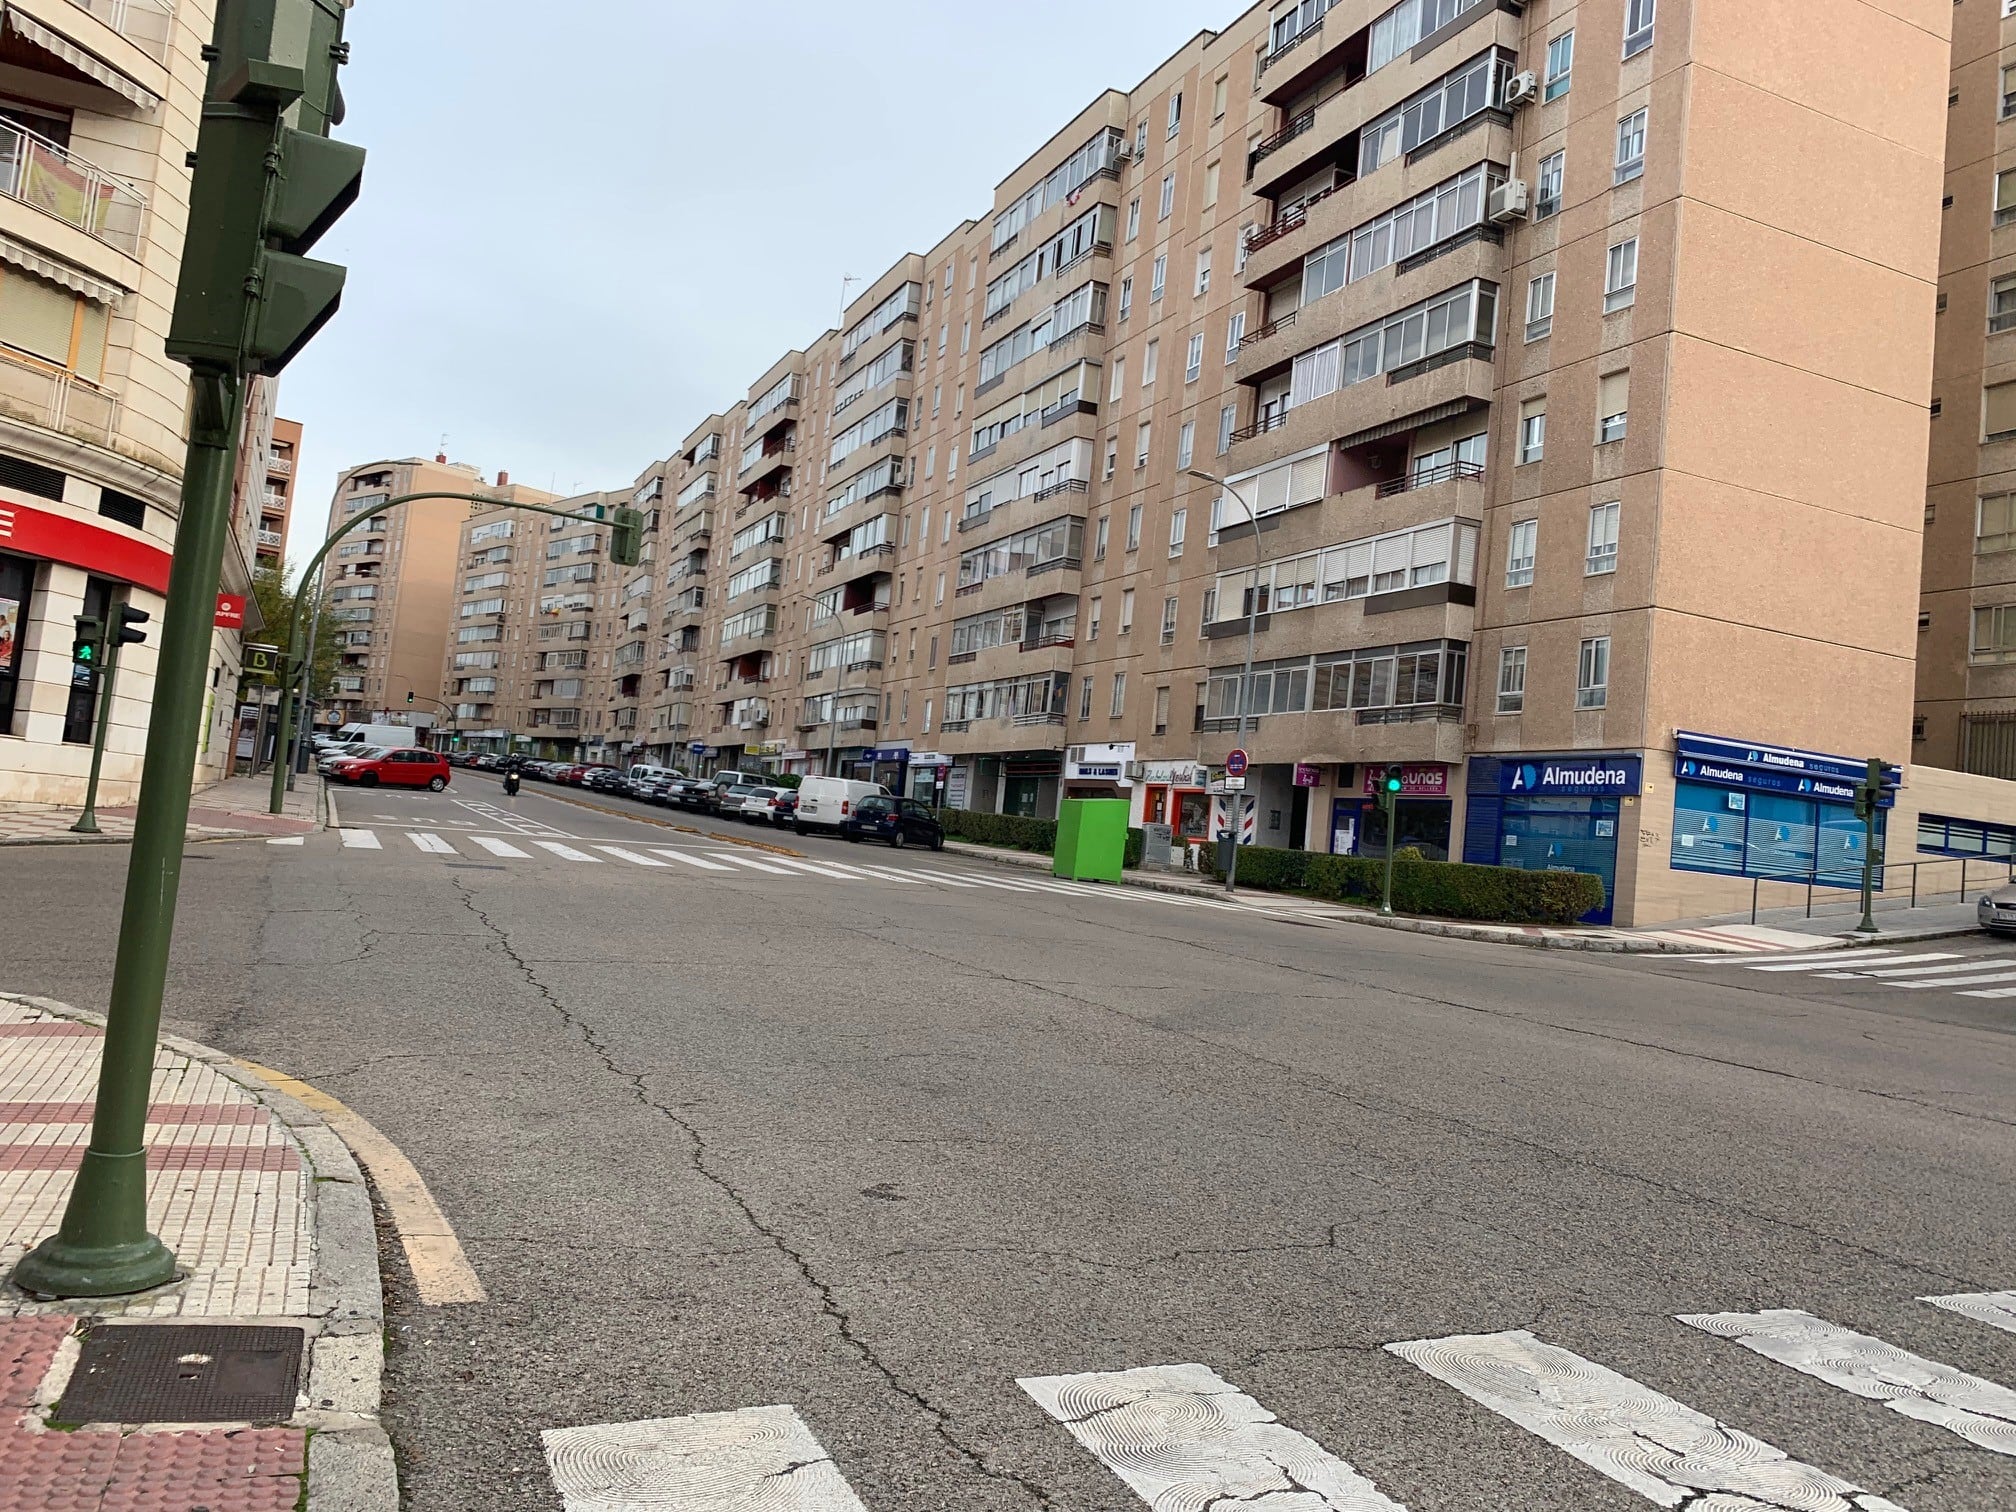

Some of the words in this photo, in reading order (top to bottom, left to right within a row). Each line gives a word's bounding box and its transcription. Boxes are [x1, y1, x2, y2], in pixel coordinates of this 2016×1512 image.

[1762, 752, 1805, 768] Almudena
[1542, 766, 1626, 785] Almudena
[1700, 765, 1744, 782] Almudena
[1813, 781, 1854, 798] Almudena
